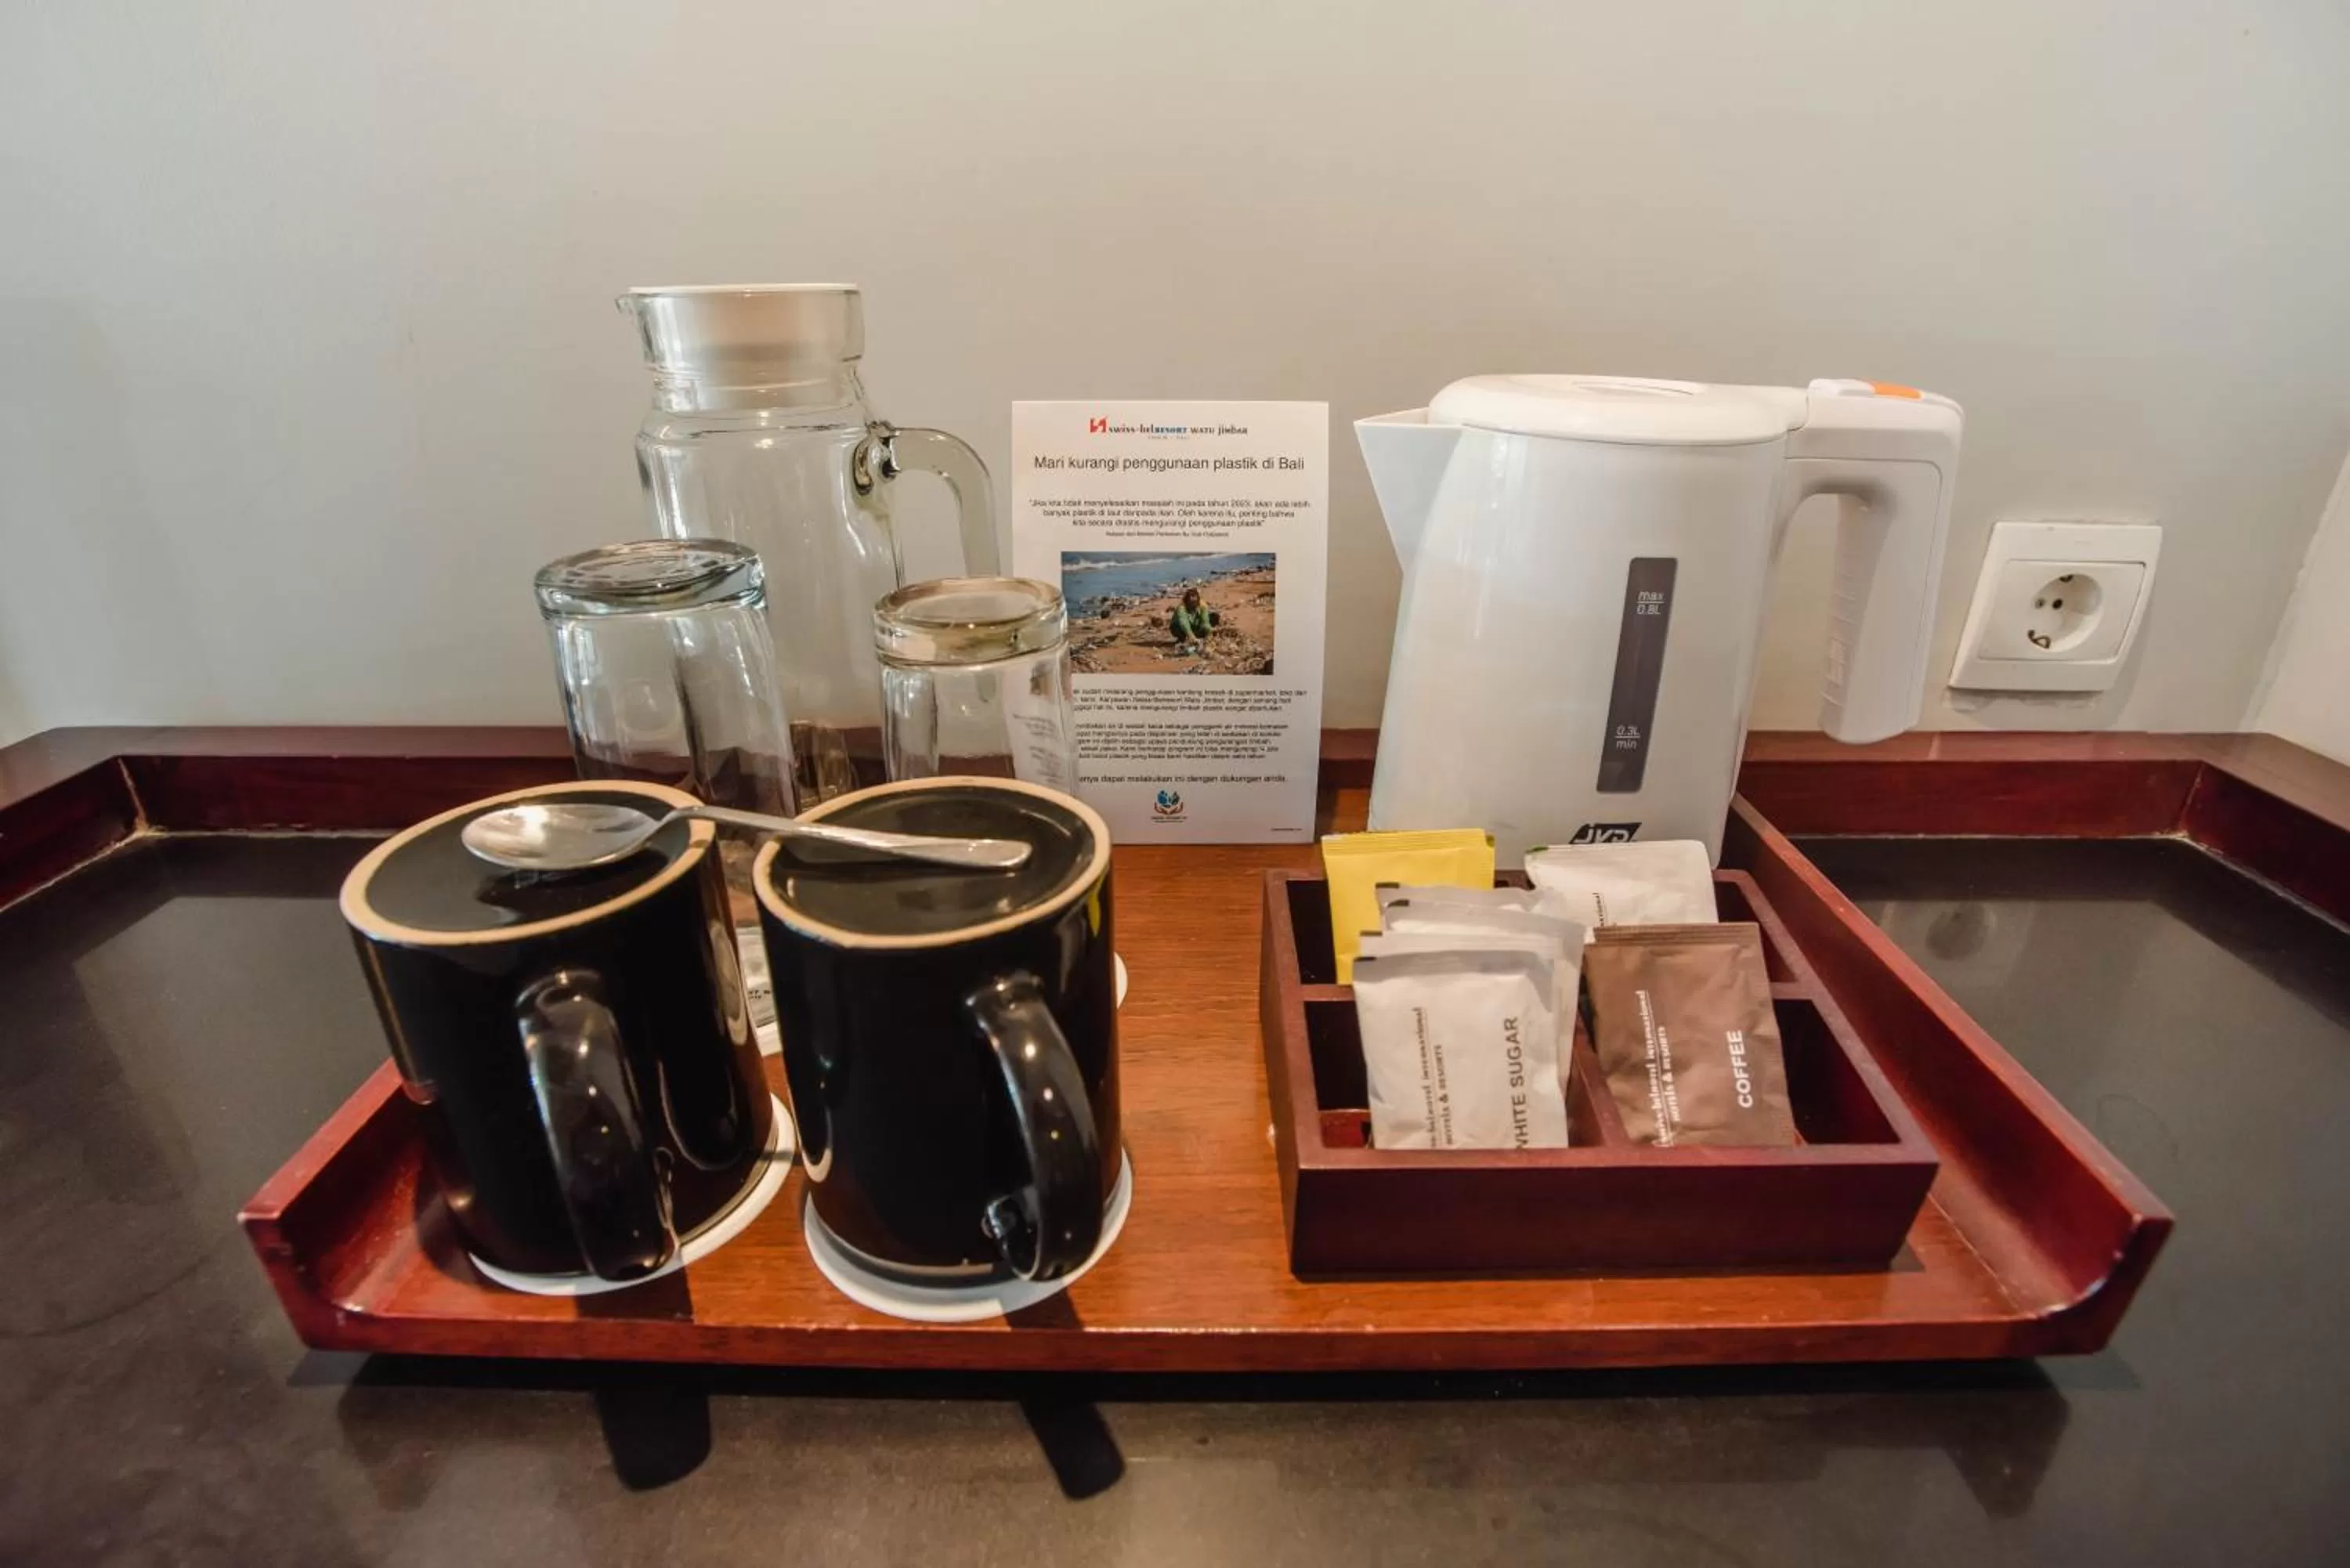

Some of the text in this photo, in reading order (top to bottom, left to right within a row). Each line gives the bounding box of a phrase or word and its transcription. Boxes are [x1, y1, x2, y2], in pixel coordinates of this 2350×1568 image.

[1034, 455, 1304, 472] Mari kurangi penggunaan plastik di Bali
[1637, 591, 1664, 602] max
[1615, 738, 1638, 750] min
[1726, 1030, 1754, 1108] COFFEE
[1661, 1071, 1673, 1082] &
[1503, 1017, 1530, 1151] WHITE SUGAR
[1438, 1093, 1448, 1104] &
